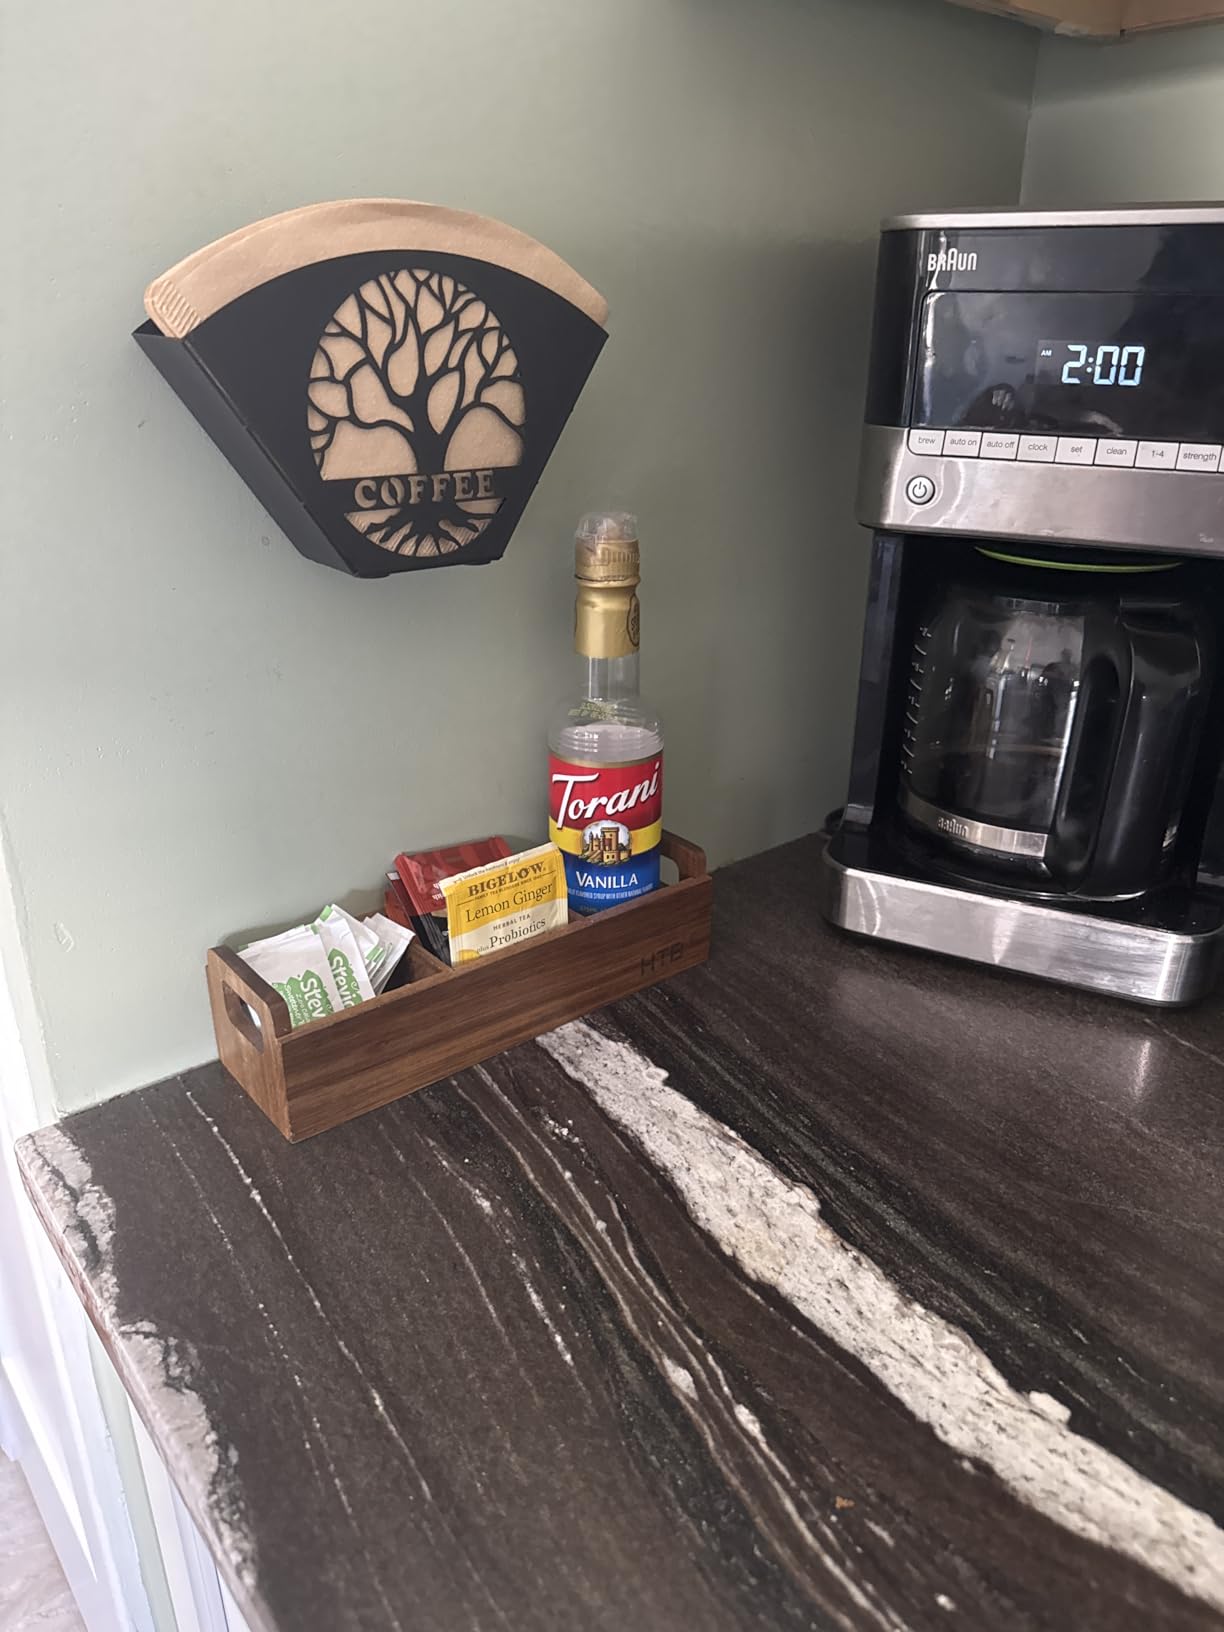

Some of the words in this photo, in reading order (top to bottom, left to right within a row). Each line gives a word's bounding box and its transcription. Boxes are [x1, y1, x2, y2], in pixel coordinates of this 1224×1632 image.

[927, 248, 977, 271] BRAUN
[1061, 344, 1145, 386] 2:00
[918, 437, 936, 445] brew
[950, 437, 966, 446] auto
[986, 440, 1003, 448] auto
[1004, 441, 1015, 449] off
[1028, 443, 1048, 451] clock
[1070, 445, 1083, 453] set
[1106, 447, 1127, 455] clean
[1151, 449, 1164, 458] 1-4
[1183, 452, 1217, 462] strength
[354, 470, 496, 509] COFFEE
[552, 761, 660, 829] Torani
[468, 861, 545, 897] BIGELOW
[576, 871, 638, 889] VANILLA
[466, 899, 510, 923] Lemon
[513, 883, 553, 902] Ginger
[493, 918, 517, 931] HERBAL
[519, 913, 531, 922] TEA
[489, 918, 546, 948] Probiotics
